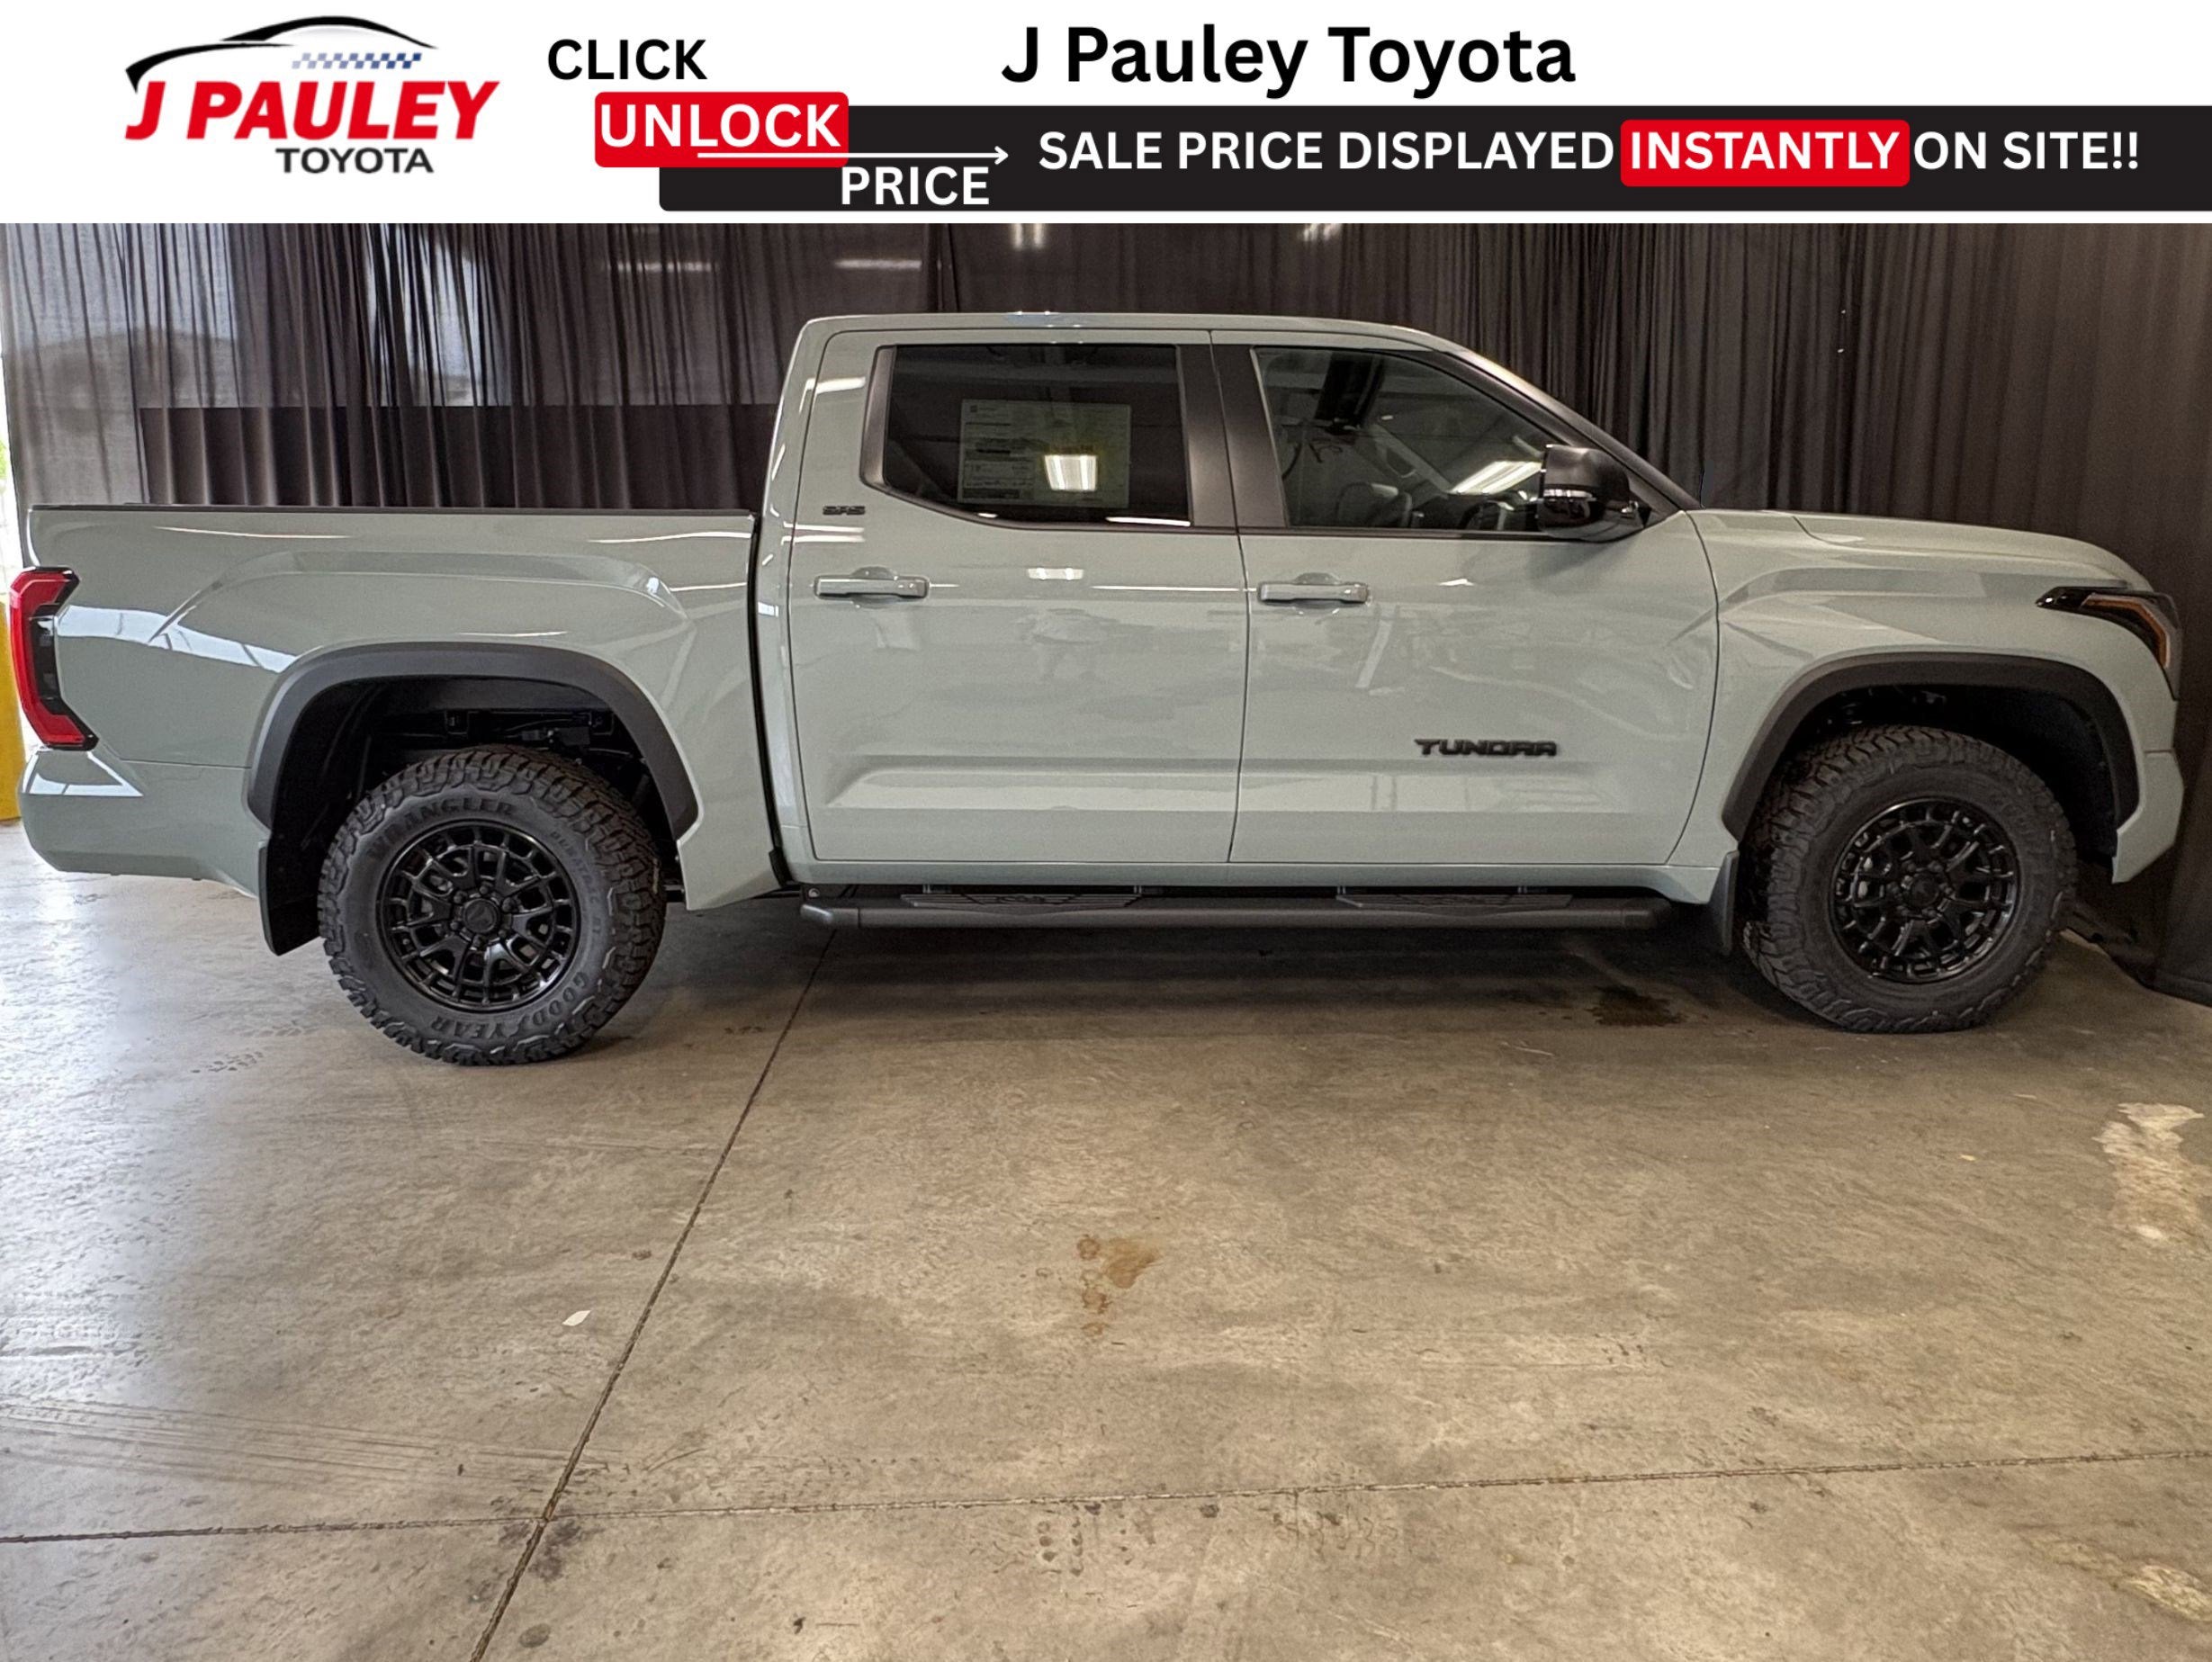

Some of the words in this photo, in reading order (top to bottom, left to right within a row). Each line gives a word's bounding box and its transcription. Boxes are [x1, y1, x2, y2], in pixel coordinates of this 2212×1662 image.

[1414, 739, 1558, 757] TUNDRA
[366, 797, 515, 860] WRANGLER
[429, 972, 588, 1038] GOODYEAR
